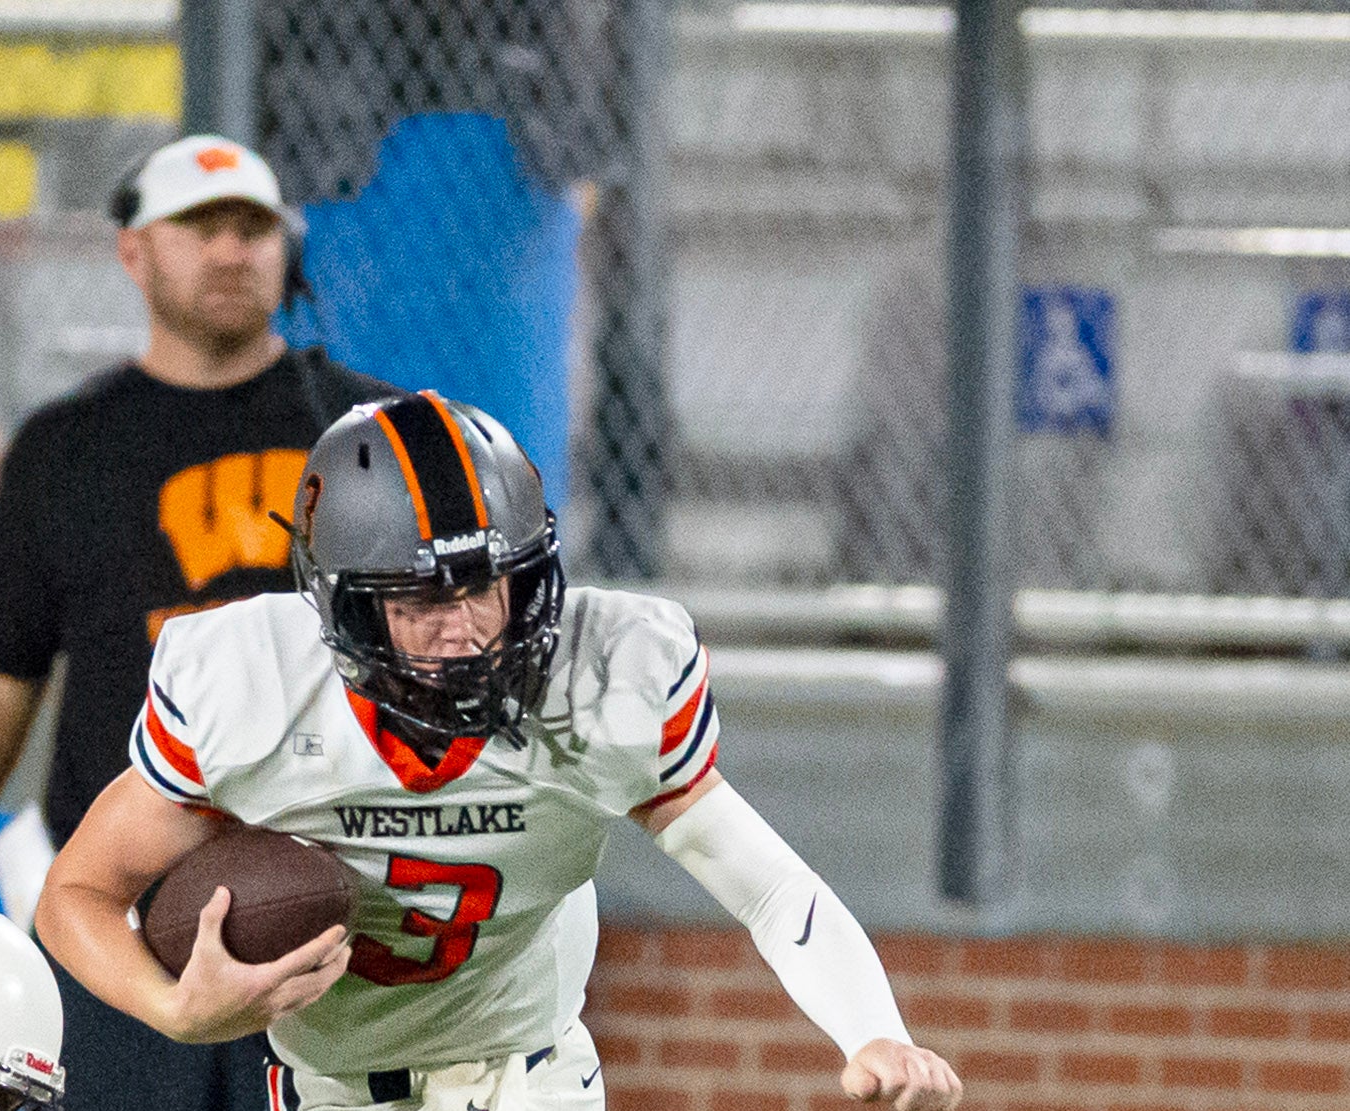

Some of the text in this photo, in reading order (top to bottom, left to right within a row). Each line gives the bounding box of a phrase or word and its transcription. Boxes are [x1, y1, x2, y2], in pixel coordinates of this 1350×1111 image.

[433, 530, 486, 555] Riddell
[334, 803, 526, 838] WESTLAKE
[347, 853, 503, 987] 3
